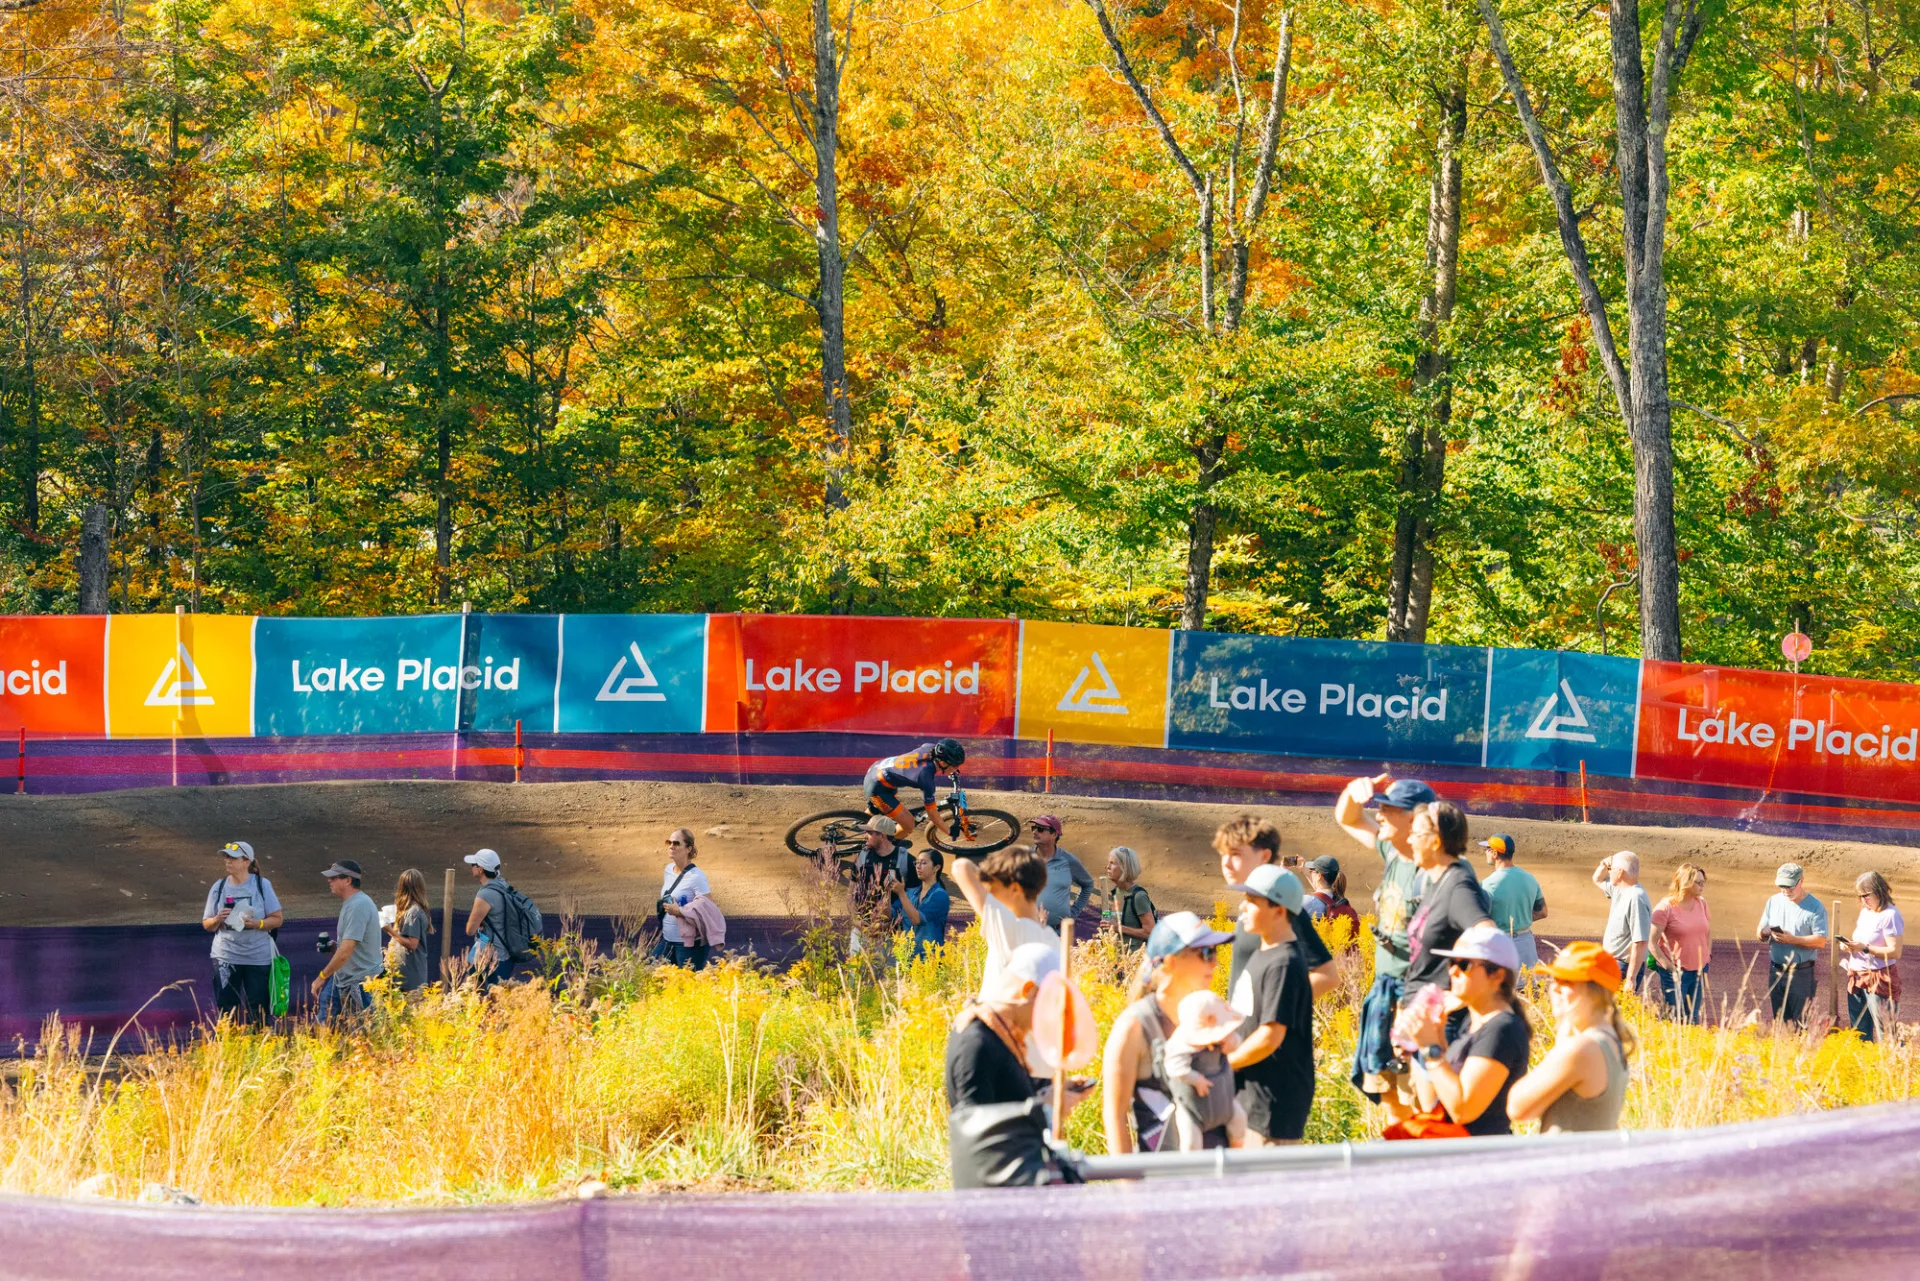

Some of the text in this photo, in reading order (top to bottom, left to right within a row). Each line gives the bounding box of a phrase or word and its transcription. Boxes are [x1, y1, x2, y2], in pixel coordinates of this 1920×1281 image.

[291, 656, 520, 692] Lake Placid
[745, 659, 980, 695] Lake Placid
[1209, 676, 1448, 721] Lake Placid
[1677, 708, 1919, 762] Lake Placid
